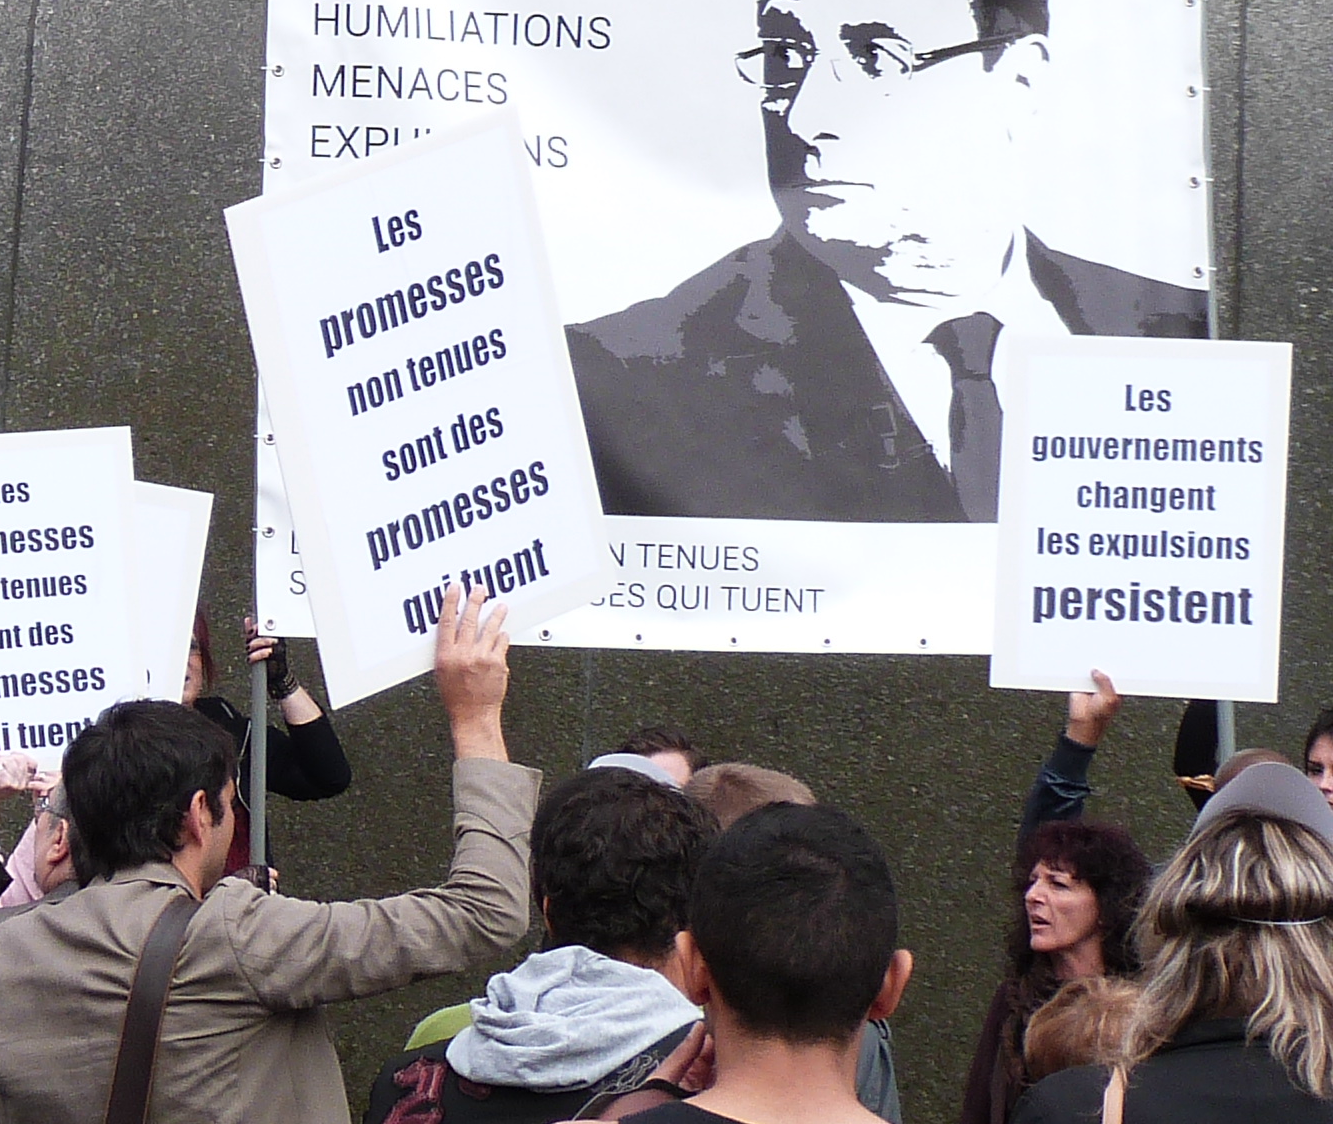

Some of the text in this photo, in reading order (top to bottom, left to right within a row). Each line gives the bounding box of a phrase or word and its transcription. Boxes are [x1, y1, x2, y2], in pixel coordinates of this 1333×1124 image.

[314, 4, 611, 49] HUMILIATIONS
[313, 64, 507, 104] MENACES
[372, 209, 422, 253] Les
[320, 253, 504, 358] promesses
[347, 327, 507, 416] non tenues
[1125, 384, 1171, 412] Les
[382, 406, 504, 481] sont des
[1031, 434, 1263, 463] gouvernements
[366, 460, 549, 570] promesses
[1077, 481, 1216, 513] changent
[636, 544, 759, 571] TENUES
[1037, 527, 1250, 560] les expulsions
[0, 575, 87, 600] tenues
[657, 585, 710, 611] QUI
[722, 585, 825, 614] TUENT
[1033, 583, 1253, 625] persistent
[29, 622, 74, 646] des
